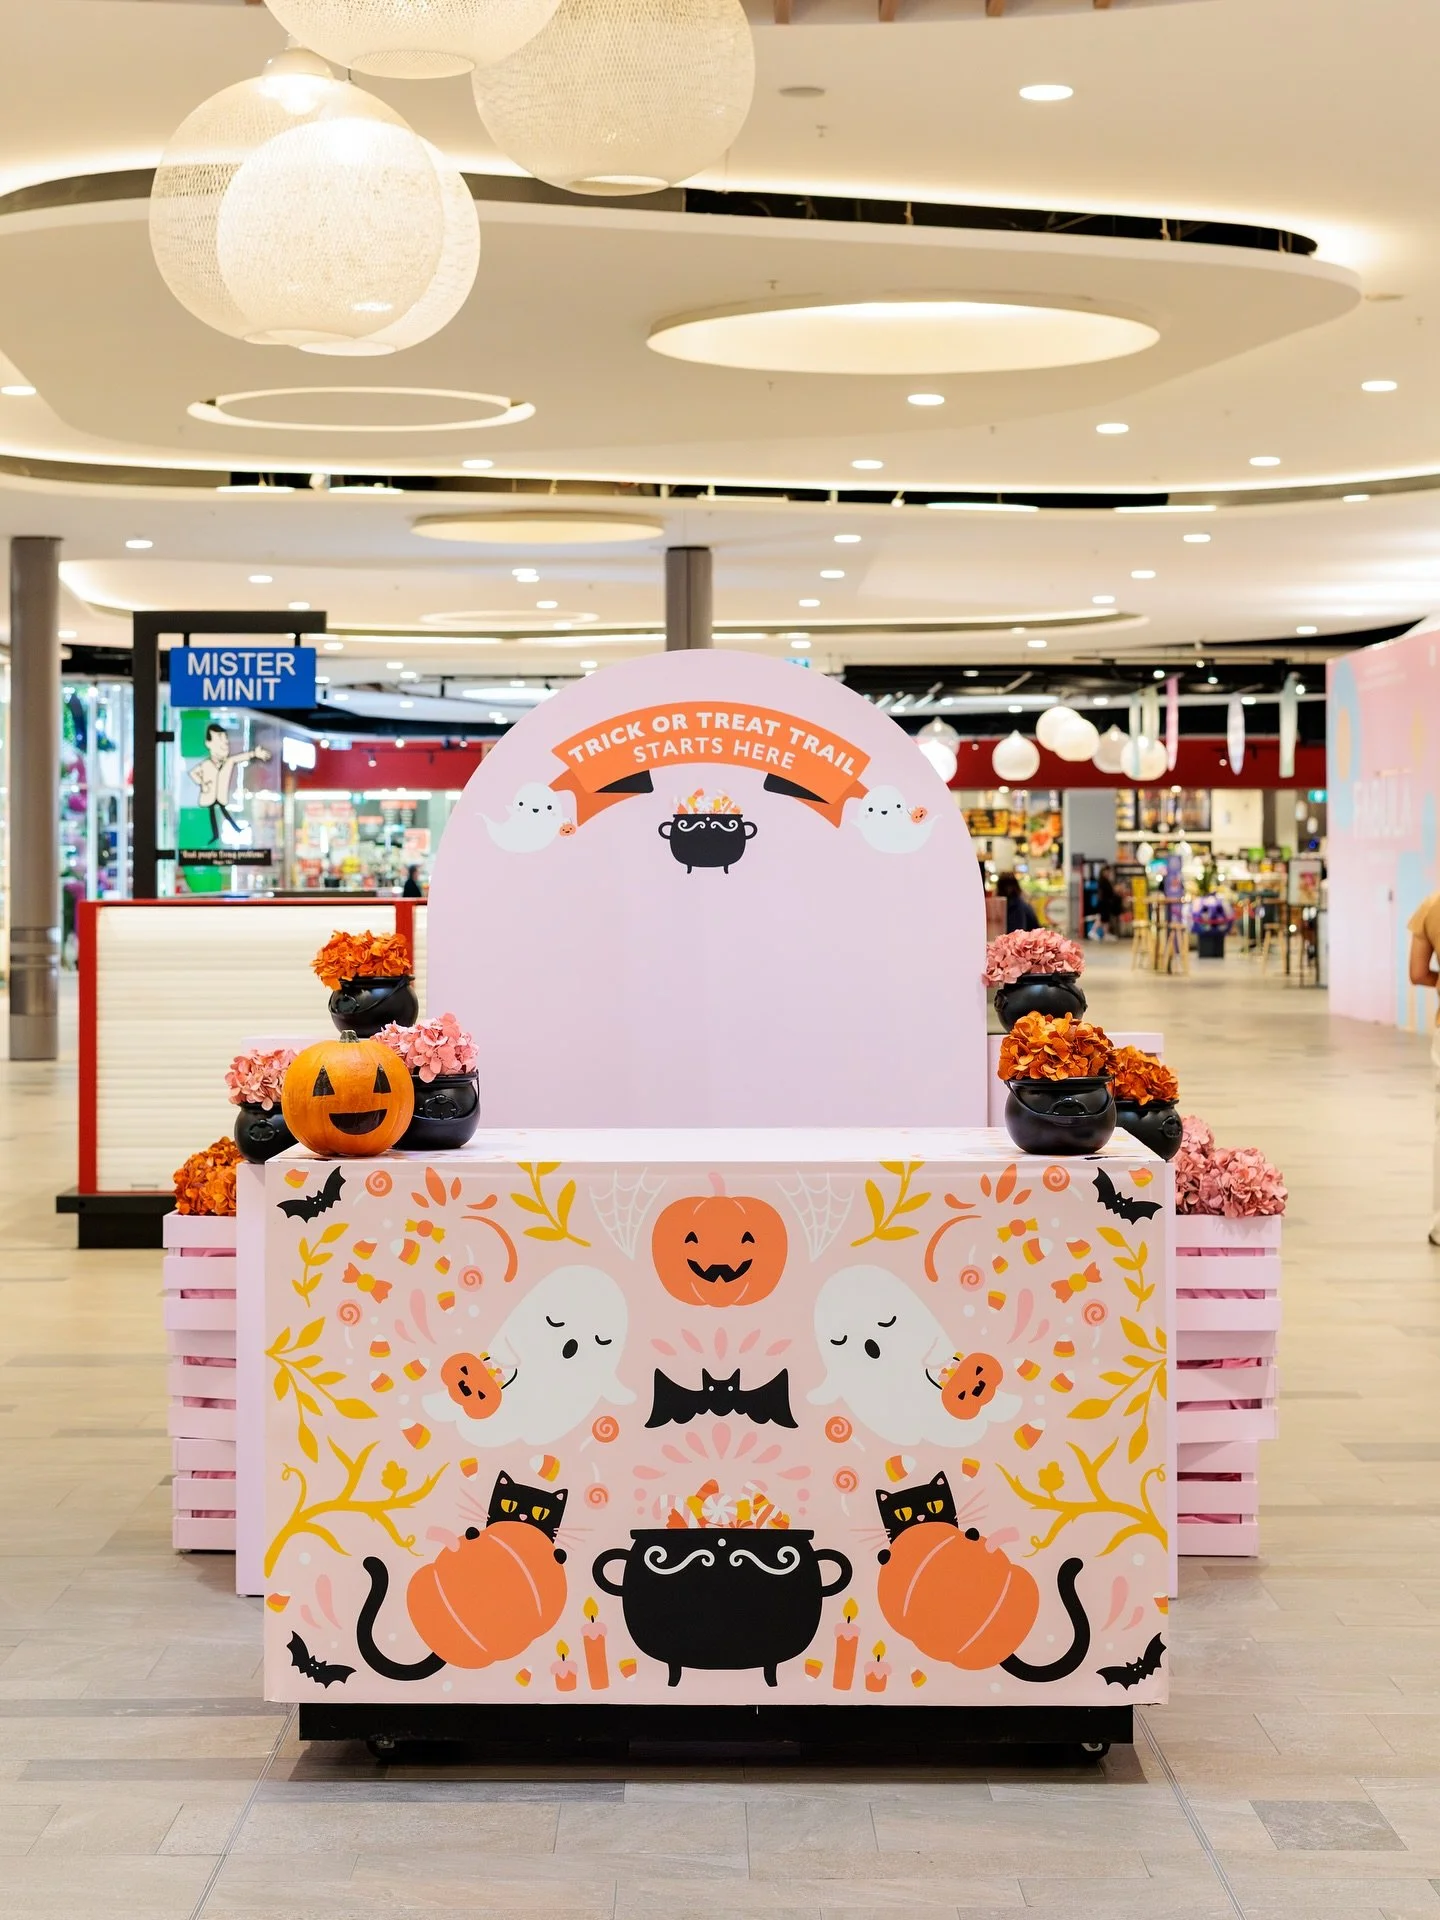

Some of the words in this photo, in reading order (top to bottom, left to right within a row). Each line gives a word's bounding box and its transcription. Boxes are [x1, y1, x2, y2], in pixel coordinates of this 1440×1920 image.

[187, 651, 296, 677] MISTER
[203, 677, 281, 701] MINIT
[567, 721, 645, 763] TRICK
[651, 713, 688, 733] OR
[696, 711, 781, 737] TREAT
[789, 726, 854, 776] TRAIL
[633, 737, 723, 763] STARTS
[733, 739, 796, 769] HERE
